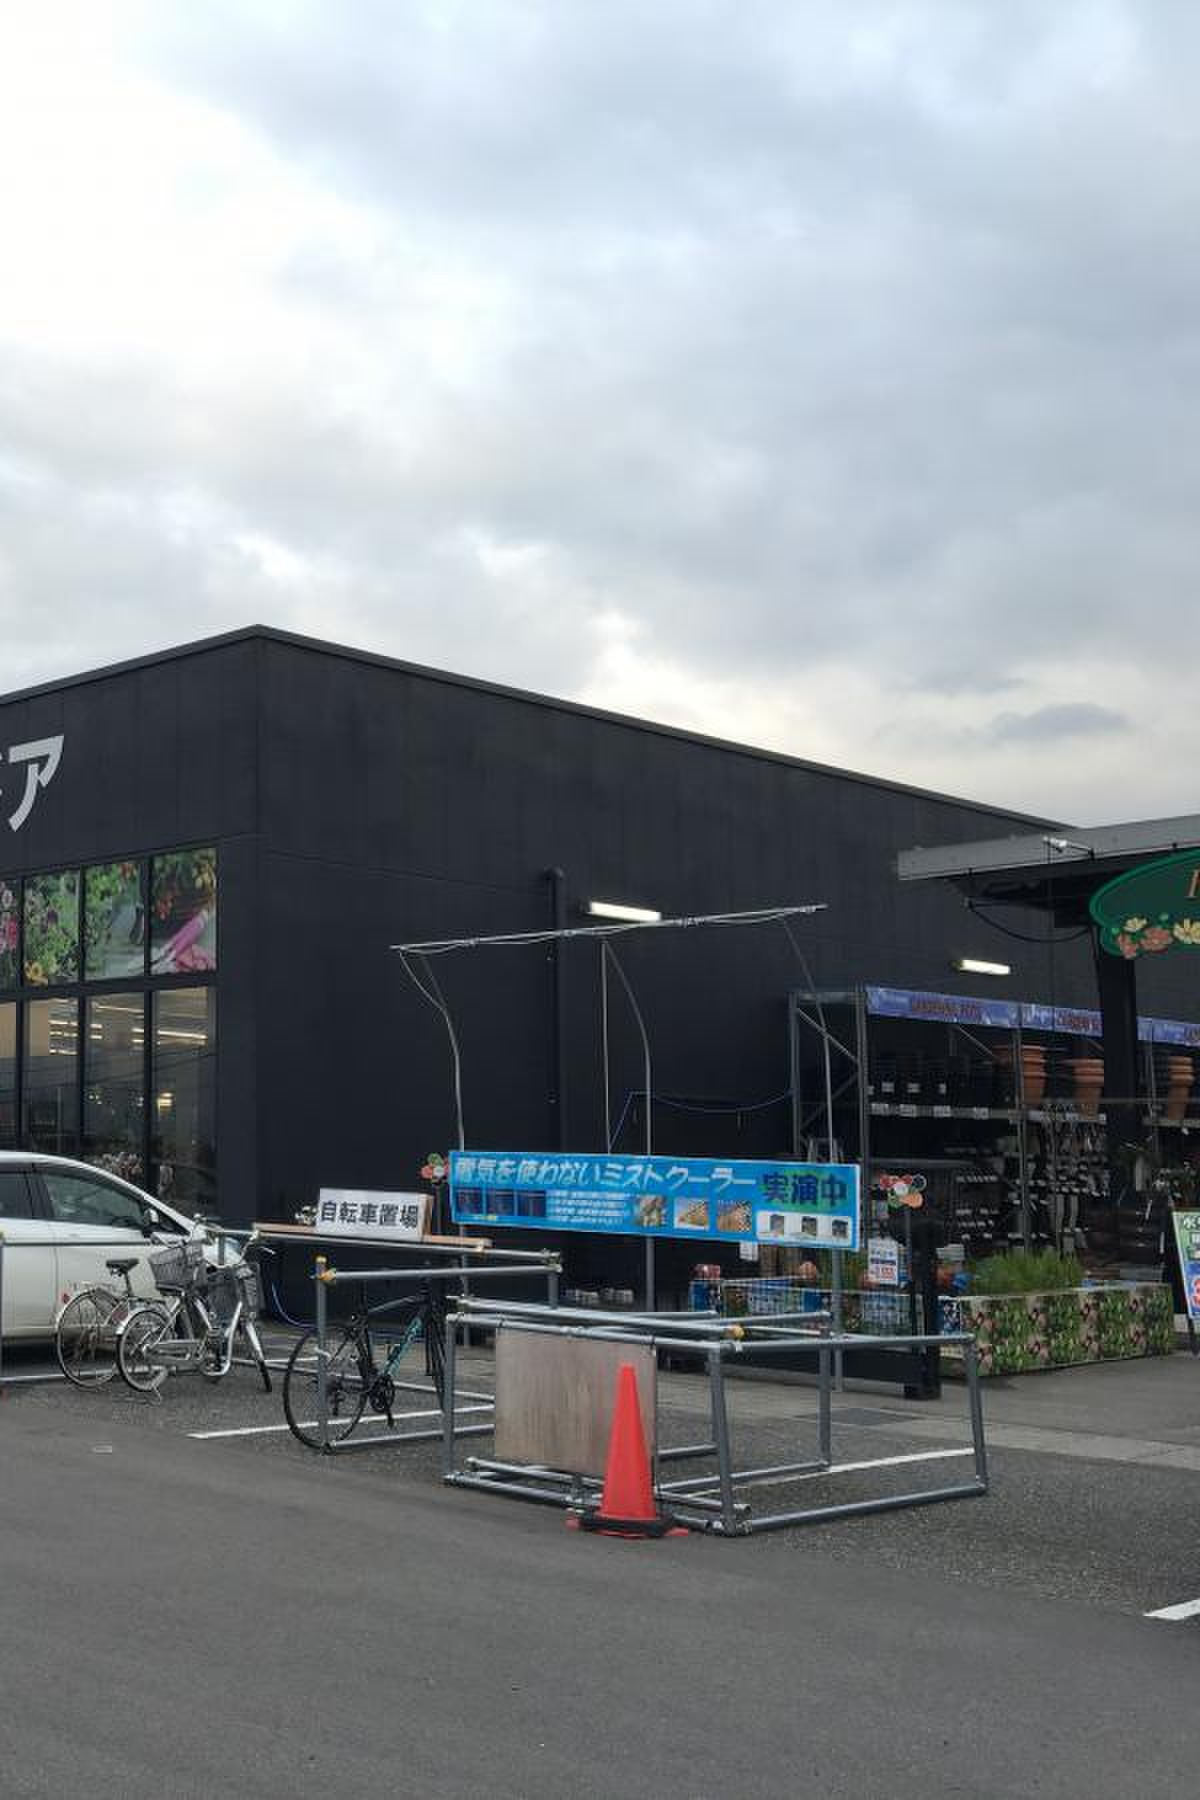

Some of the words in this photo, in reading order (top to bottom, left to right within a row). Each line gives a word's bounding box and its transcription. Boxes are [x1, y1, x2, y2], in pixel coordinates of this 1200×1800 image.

[761, 1171, 848, 1207] 実演中
[321, 1200, 419, 1228] 自転車置場
